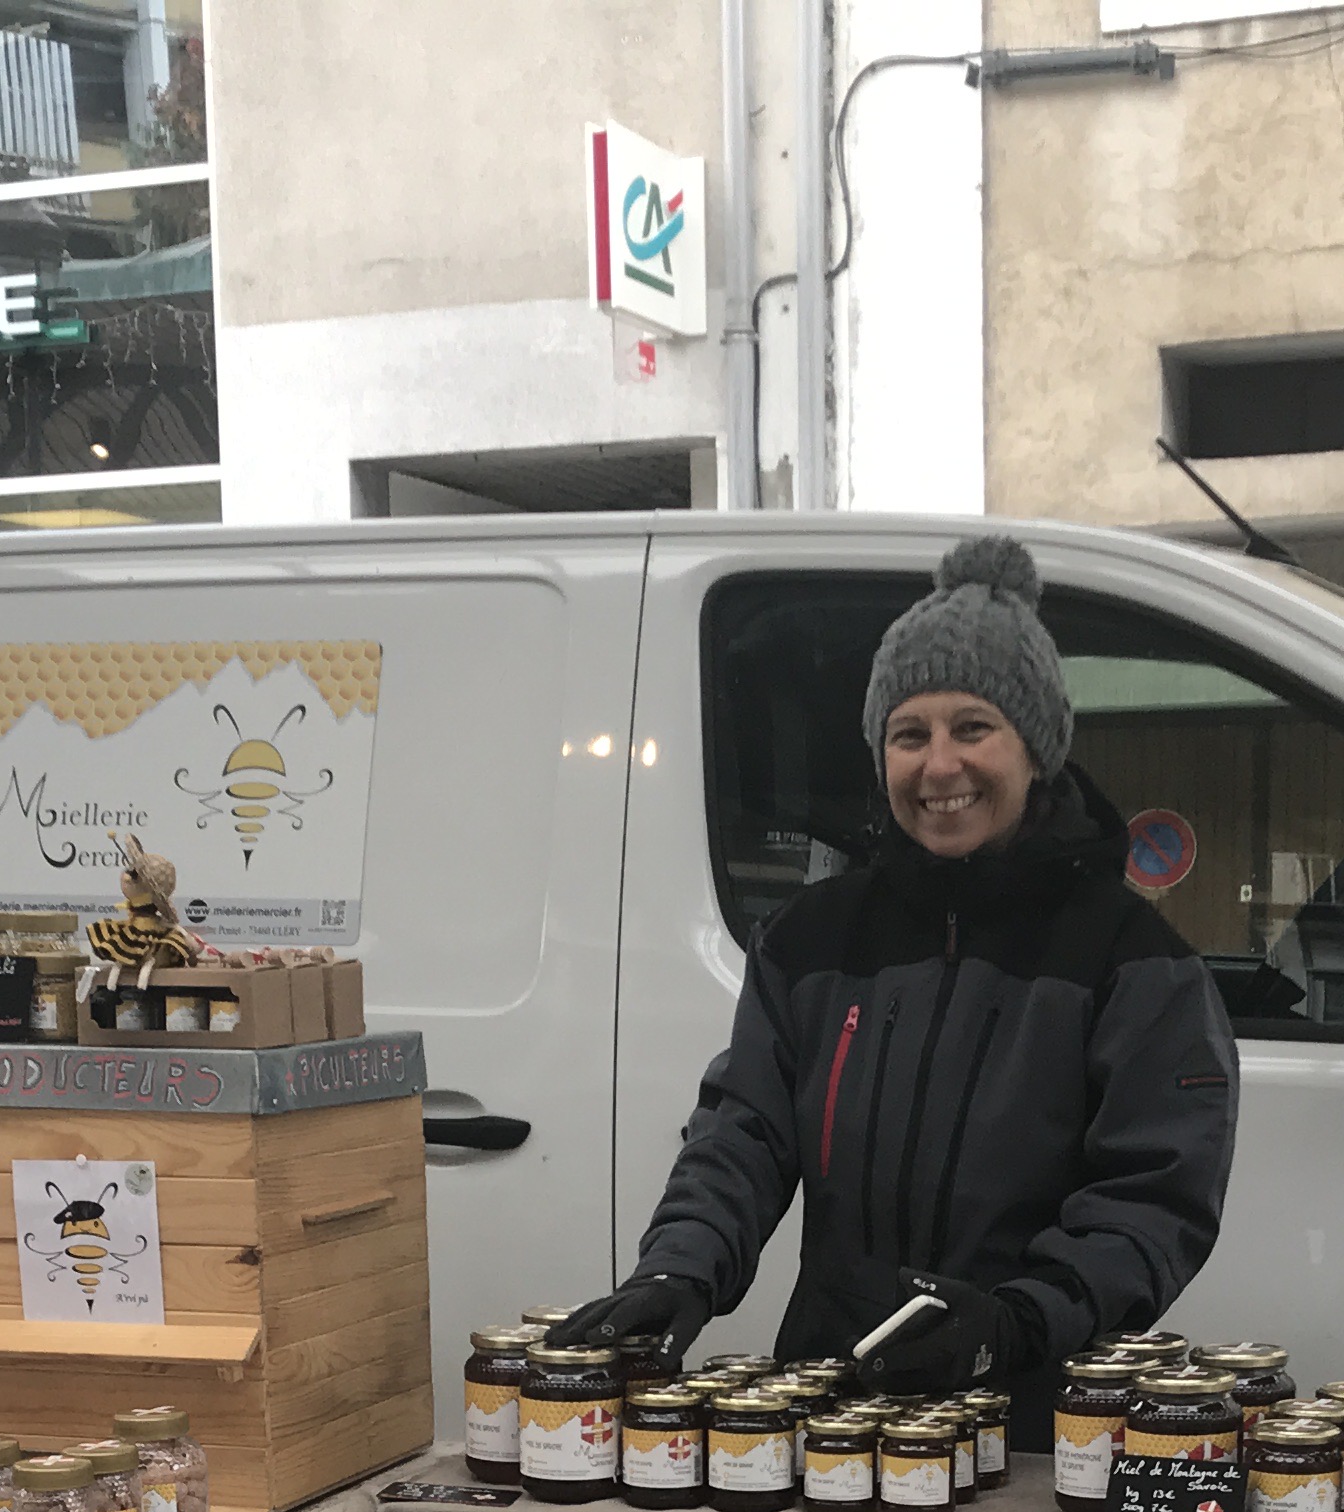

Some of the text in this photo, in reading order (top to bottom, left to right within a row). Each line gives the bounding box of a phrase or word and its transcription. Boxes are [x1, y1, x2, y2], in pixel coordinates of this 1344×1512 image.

[1113, 1460, 1241, 1484] Miel de Montagne de
[1125, 1485, 1140, 1501] kg
[1187, 1480, 1233, 1492] Savoie
